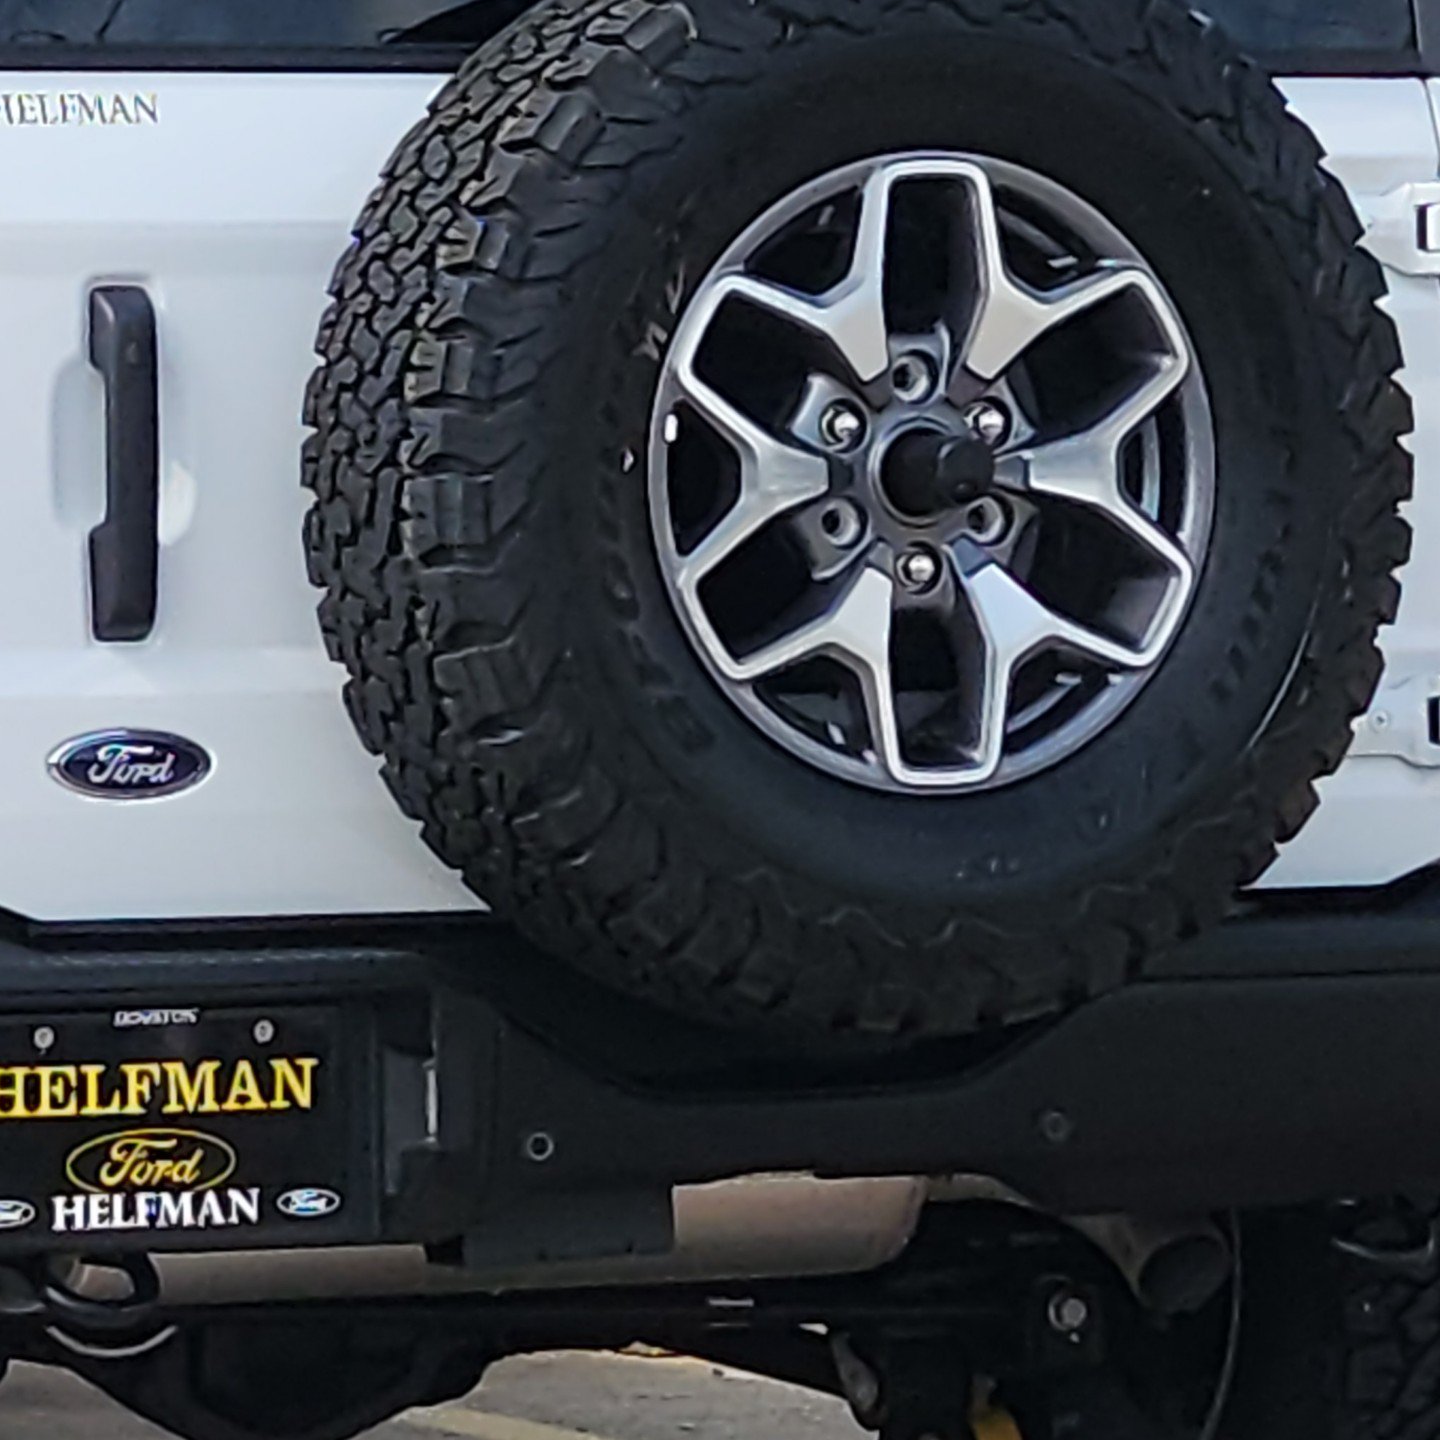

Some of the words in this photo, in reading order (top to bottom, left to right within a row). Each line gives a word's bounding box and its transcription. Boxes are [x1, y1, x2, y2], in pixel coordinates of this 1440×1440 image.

[87, 743, 177, 785] Ford
[99, 1139, 205, 1188] Ford
[50, 1188, 262, 1232] HELFMAN
